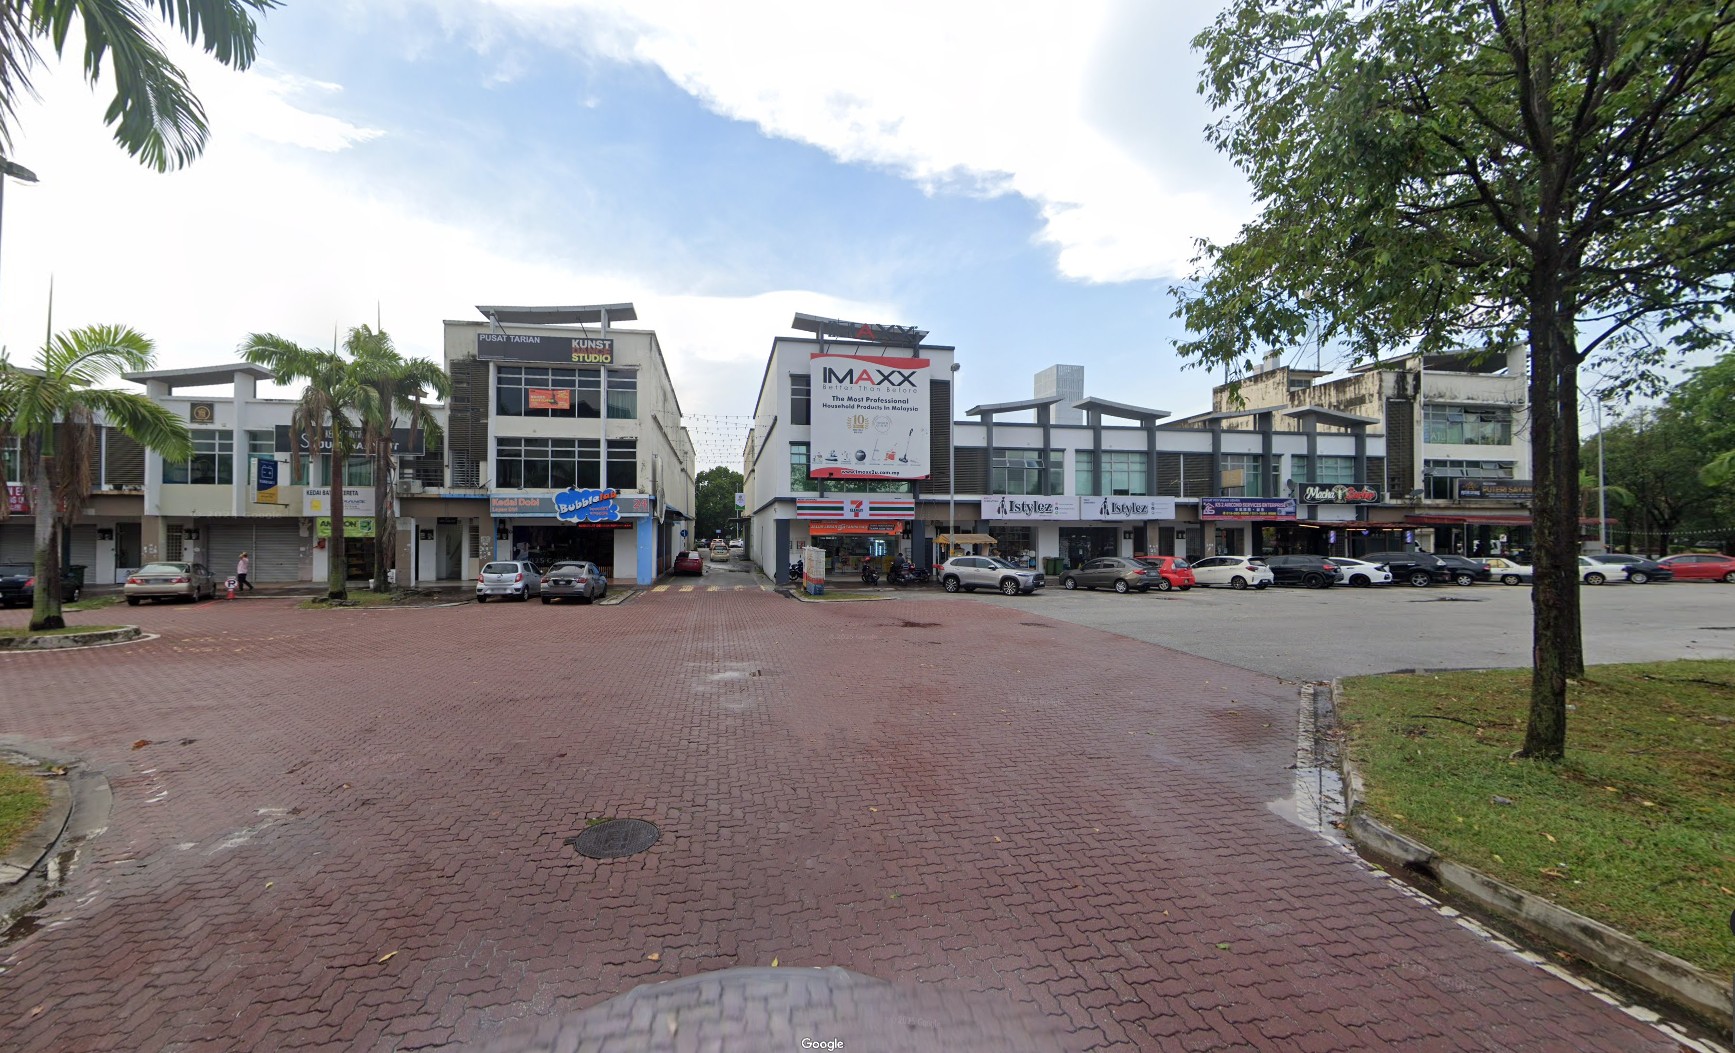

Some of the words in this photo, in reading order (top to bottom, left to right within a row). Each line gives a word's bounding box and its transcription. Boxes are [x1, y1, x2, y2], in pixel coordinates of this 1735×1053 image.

[572, 340, 610, 349] KUNST
[572, 353, 610, 362] STUDIO
[823, 367, 917, 387] IMAXX
[1009, 500, 1053, 516] Istylez
[1111, 502, 1149, 517] Istylez
